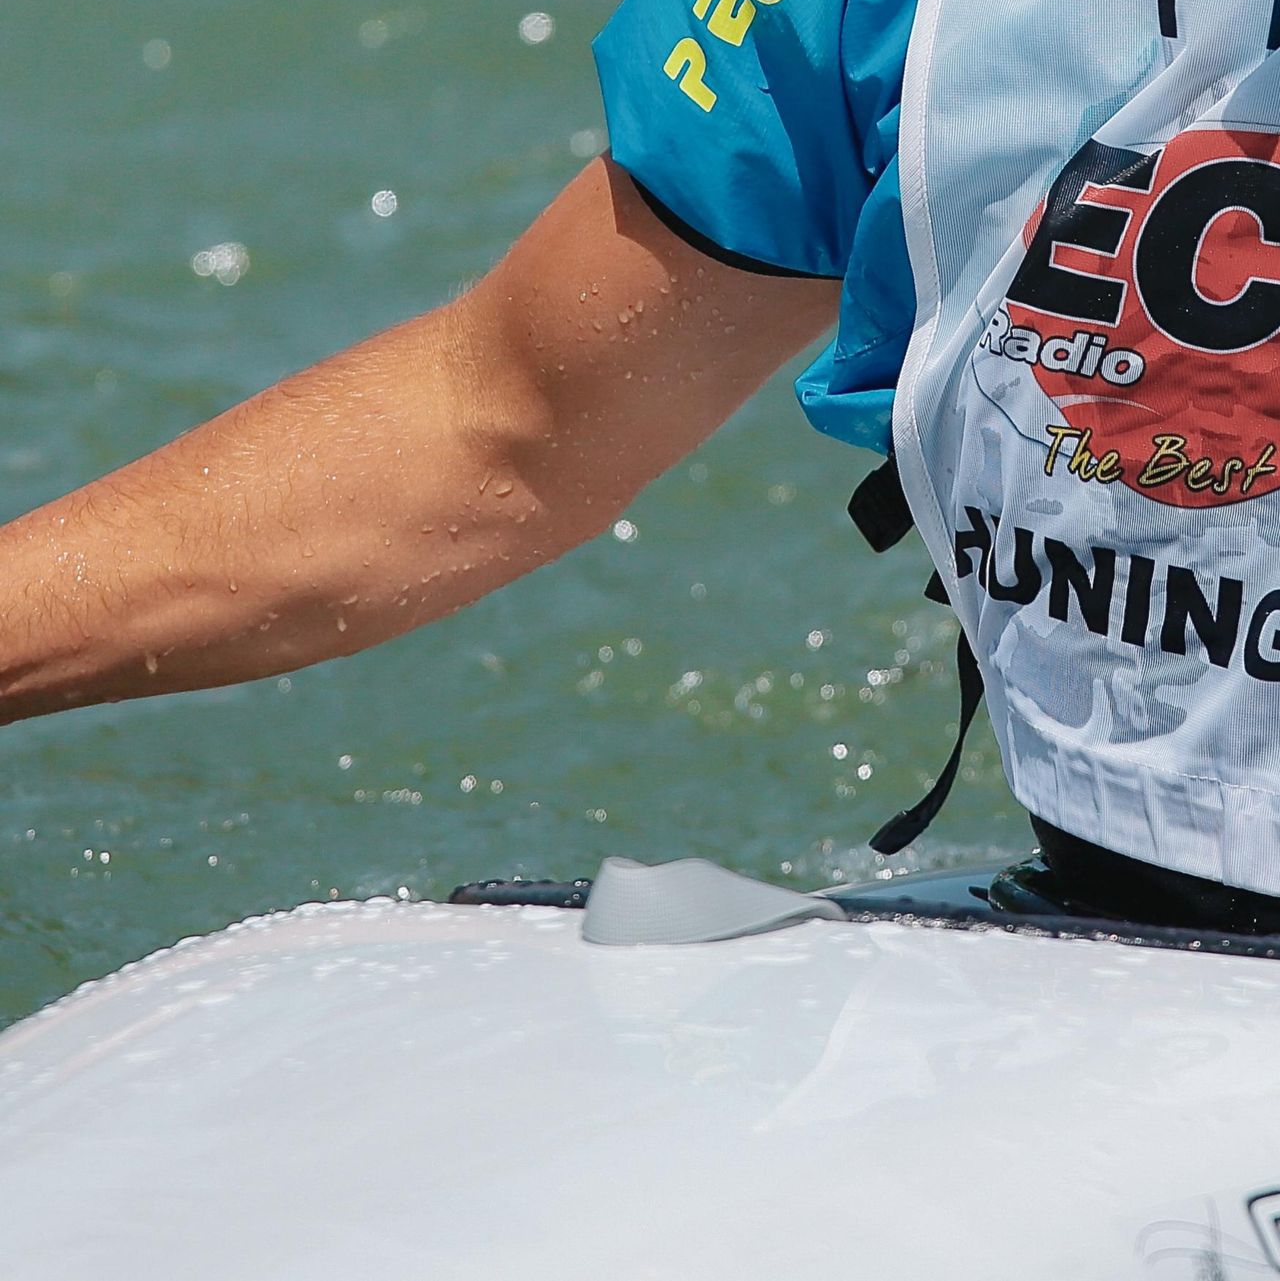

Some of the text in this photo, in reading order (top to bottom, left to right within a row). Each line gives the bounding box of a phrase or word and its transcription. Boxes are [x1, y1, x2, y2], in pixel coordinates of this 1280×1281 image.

[979, 307, 1146, 387] Radio
[1044, 424, 1123, 485] The
[1136, 433, 1278, 496] Best
